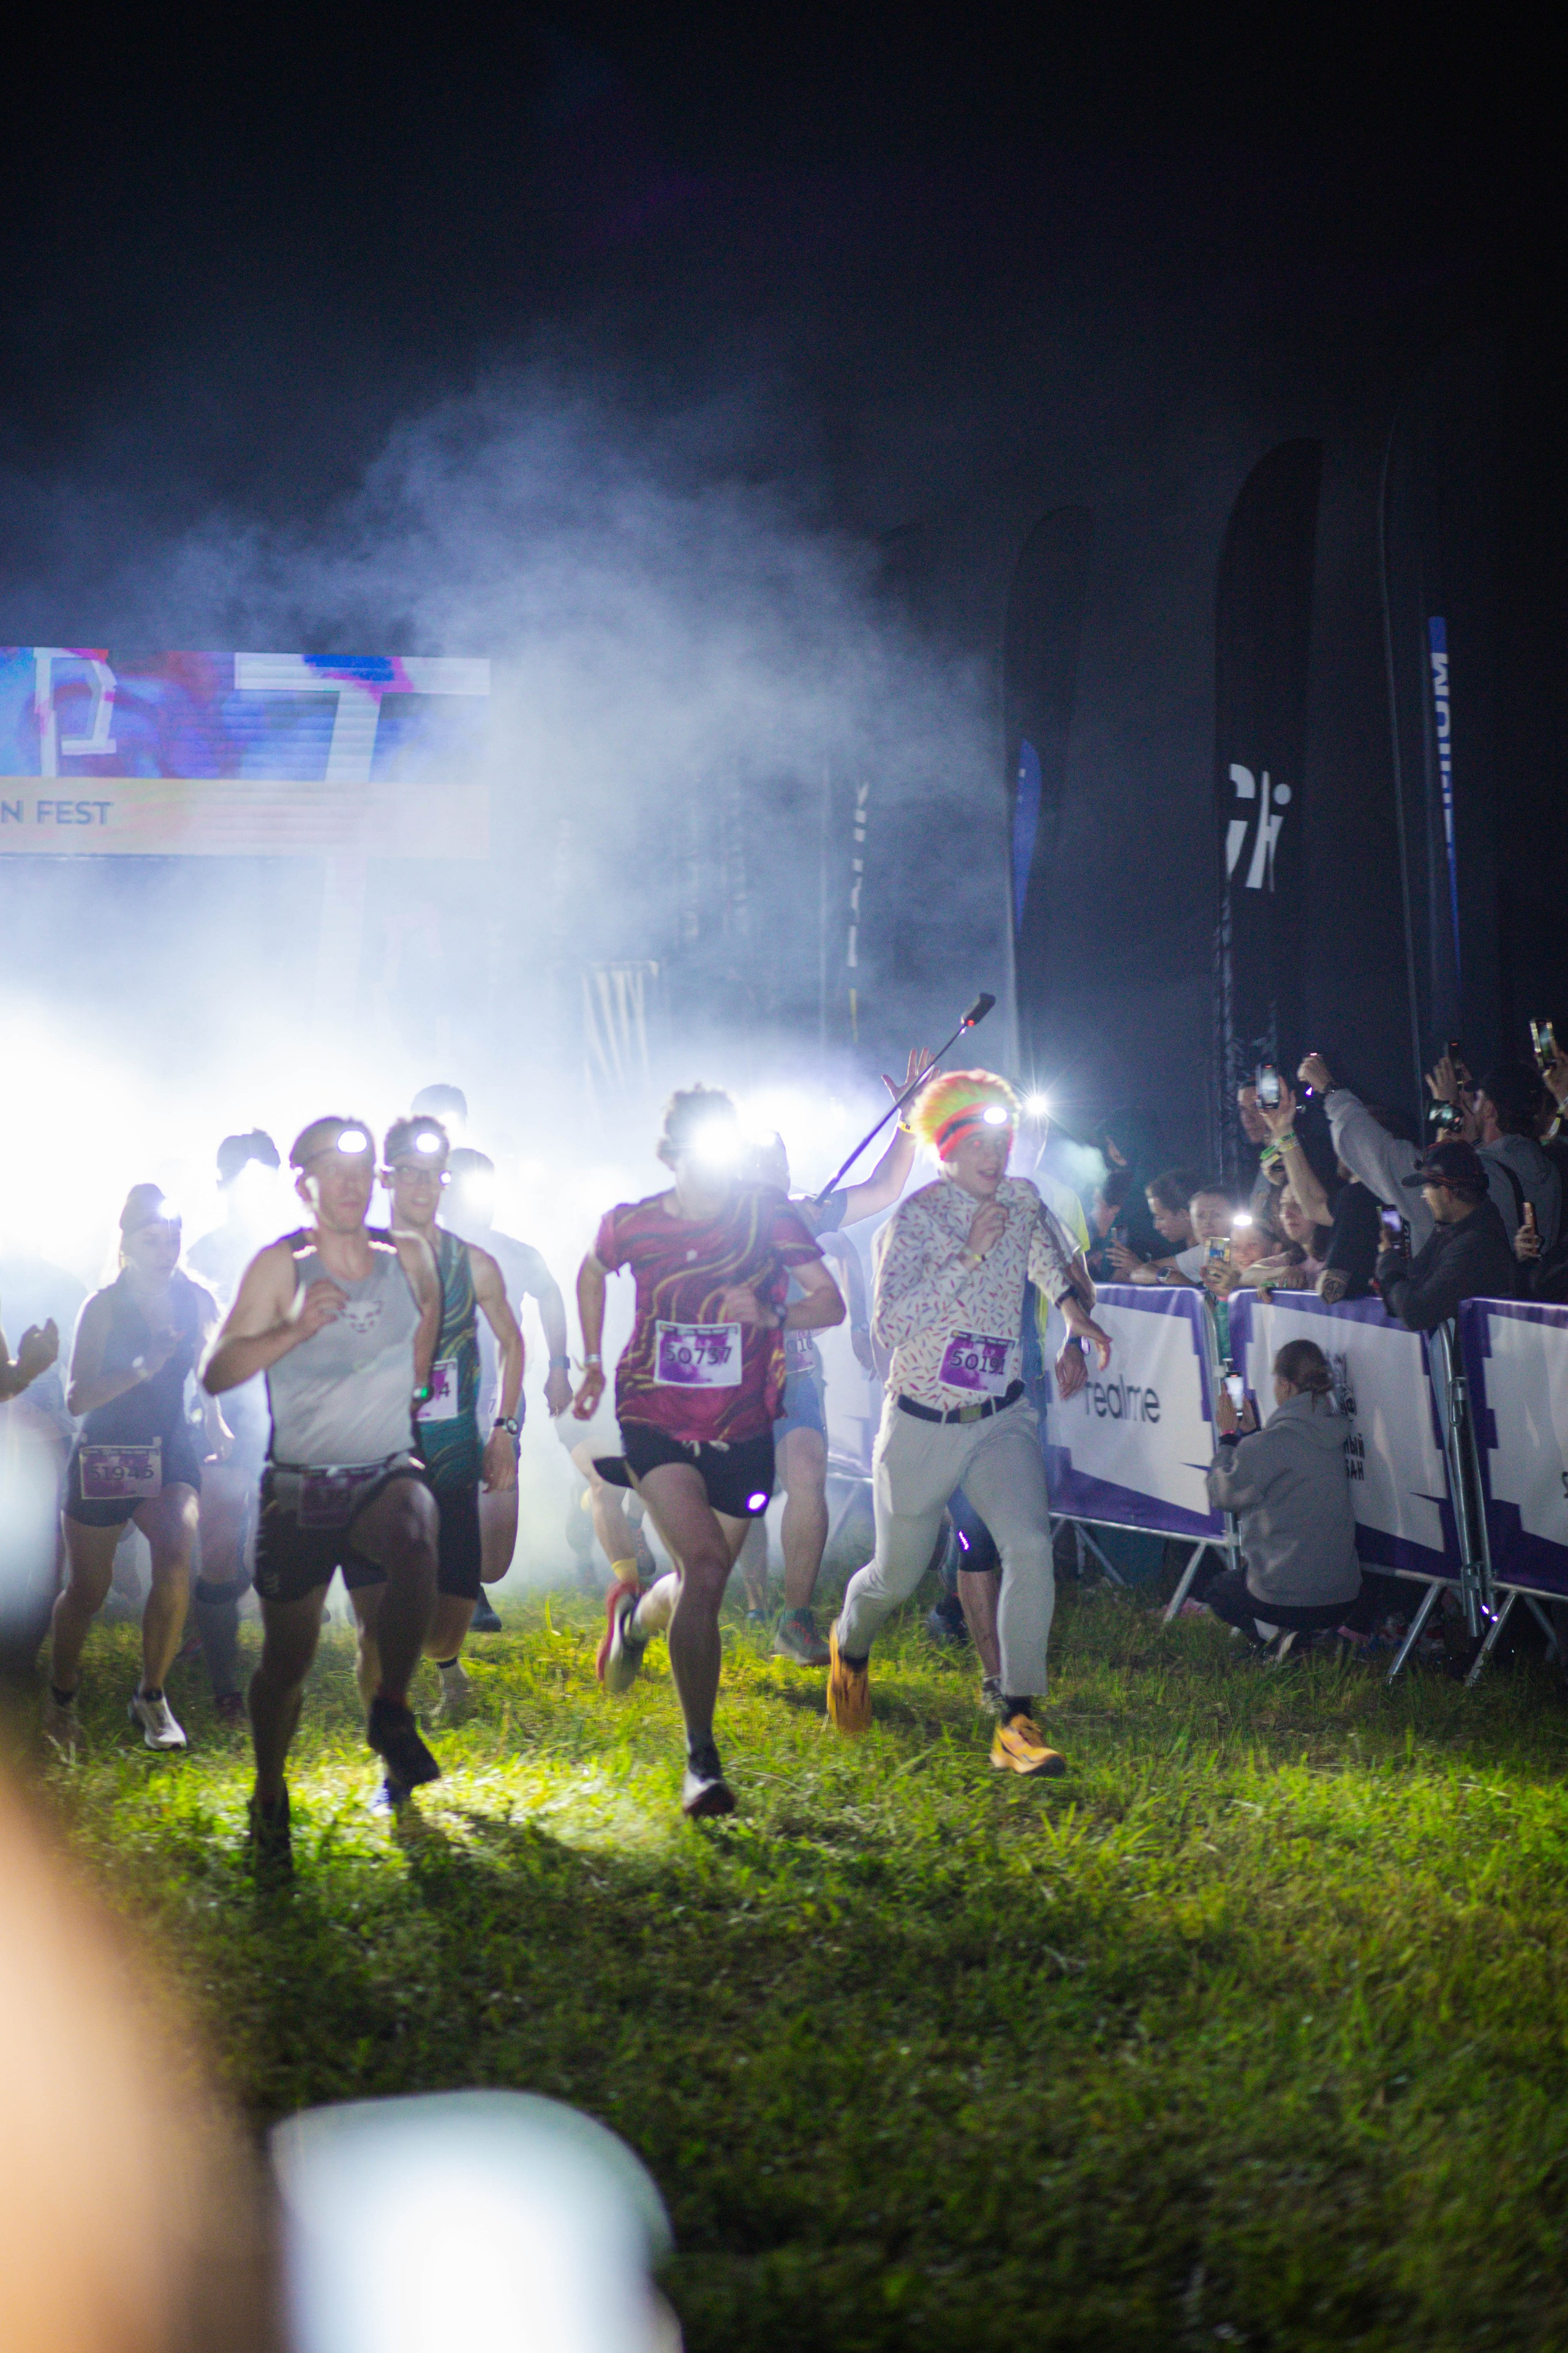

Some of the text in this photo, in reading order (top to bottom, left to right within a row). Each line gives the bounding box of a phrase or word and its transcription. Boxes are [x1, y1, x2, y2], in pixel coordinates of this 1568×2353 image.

[37, 800, 114, 825] FEST
[665, 1343, 732, 1365] 50737
[949, 1350, 1006, 1375] 50191
[1085, 1374, 1161, 1424] realme
